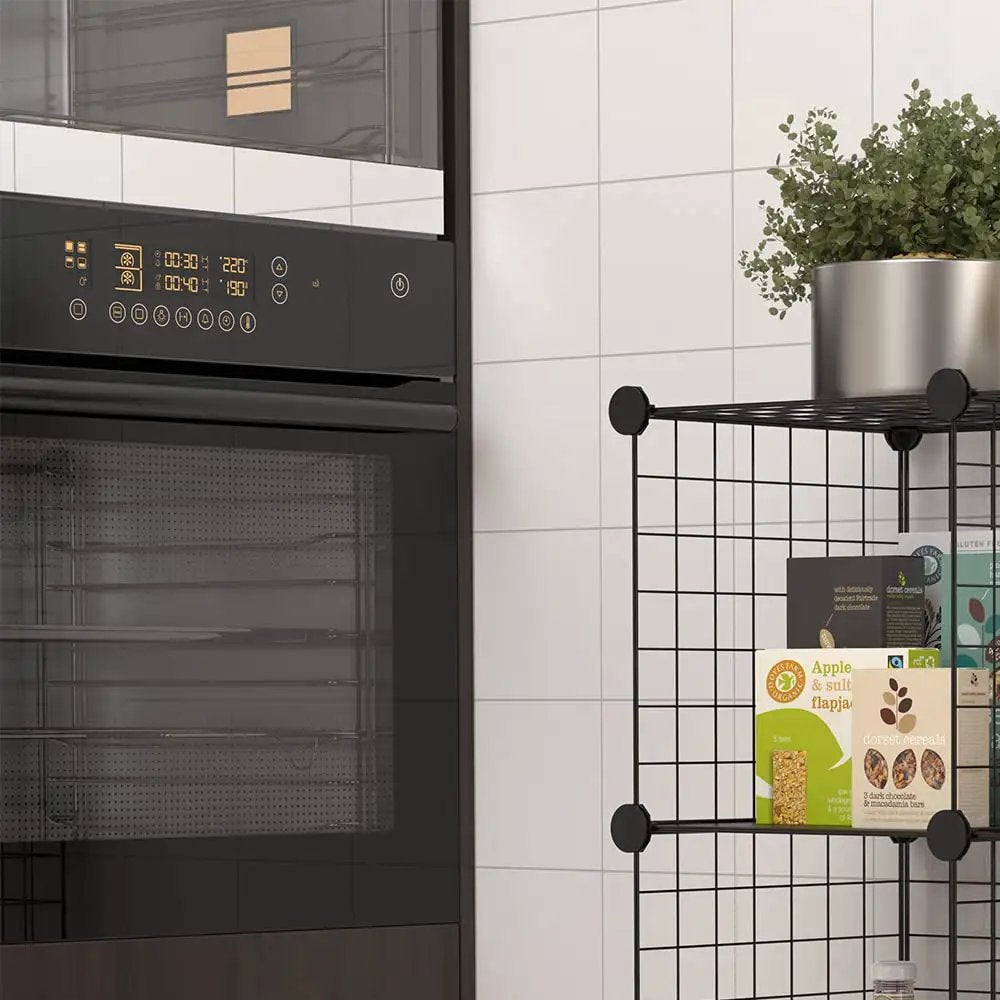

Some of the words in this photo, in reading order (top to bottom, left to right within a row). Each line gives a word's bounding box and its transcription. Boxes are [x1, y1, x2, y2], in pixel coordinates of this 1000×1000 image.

[165, 251, 198, 270] 00:30
[222, 256, 245, 274] 220
[165, 275, 198, 293] 00:40
[812, 660, 852, 677] Apple
[812, 681, 822, 692] &
[864, 735, 901, 746] dorset
[903, 735, 946, 746] cereals
[863, 792, 869, 800] 3
[869, 791, 885, 800] dark
[885, 791, 917, 800] chocolate
[863, 800, 869, 808] &
[870, 800, 909, 808] macadamia
[910, 800, 925, 808] bars
